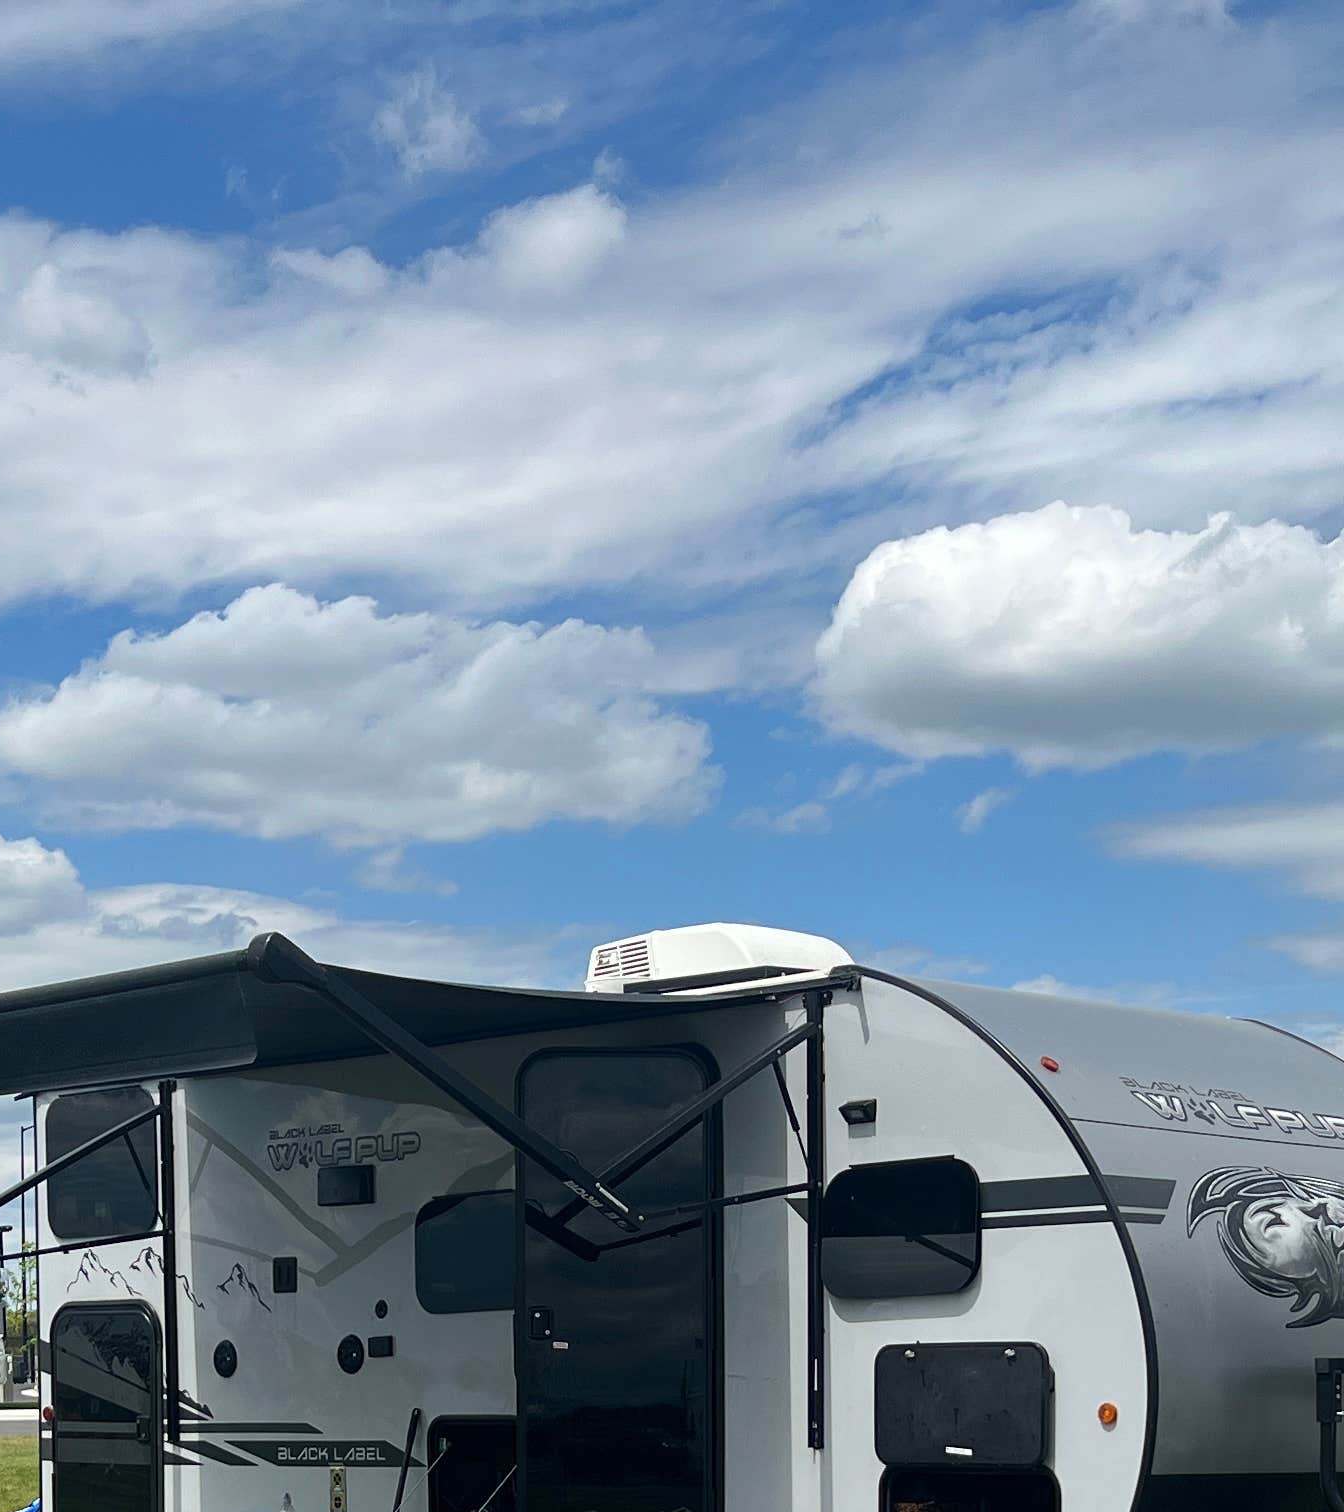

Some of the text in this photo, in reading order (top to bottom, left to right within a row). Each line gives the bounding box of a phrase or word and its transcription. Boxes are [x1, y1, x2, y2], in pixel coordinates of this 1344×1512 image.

[1119, 1077, 1255, 1102] BLACK LABEL
[269, 1124, 344, 1140] BLACK LABEL
[356, 1131, 421, 1163] PUP
[277, 1447, 385, 1460] BLACK LABEL
